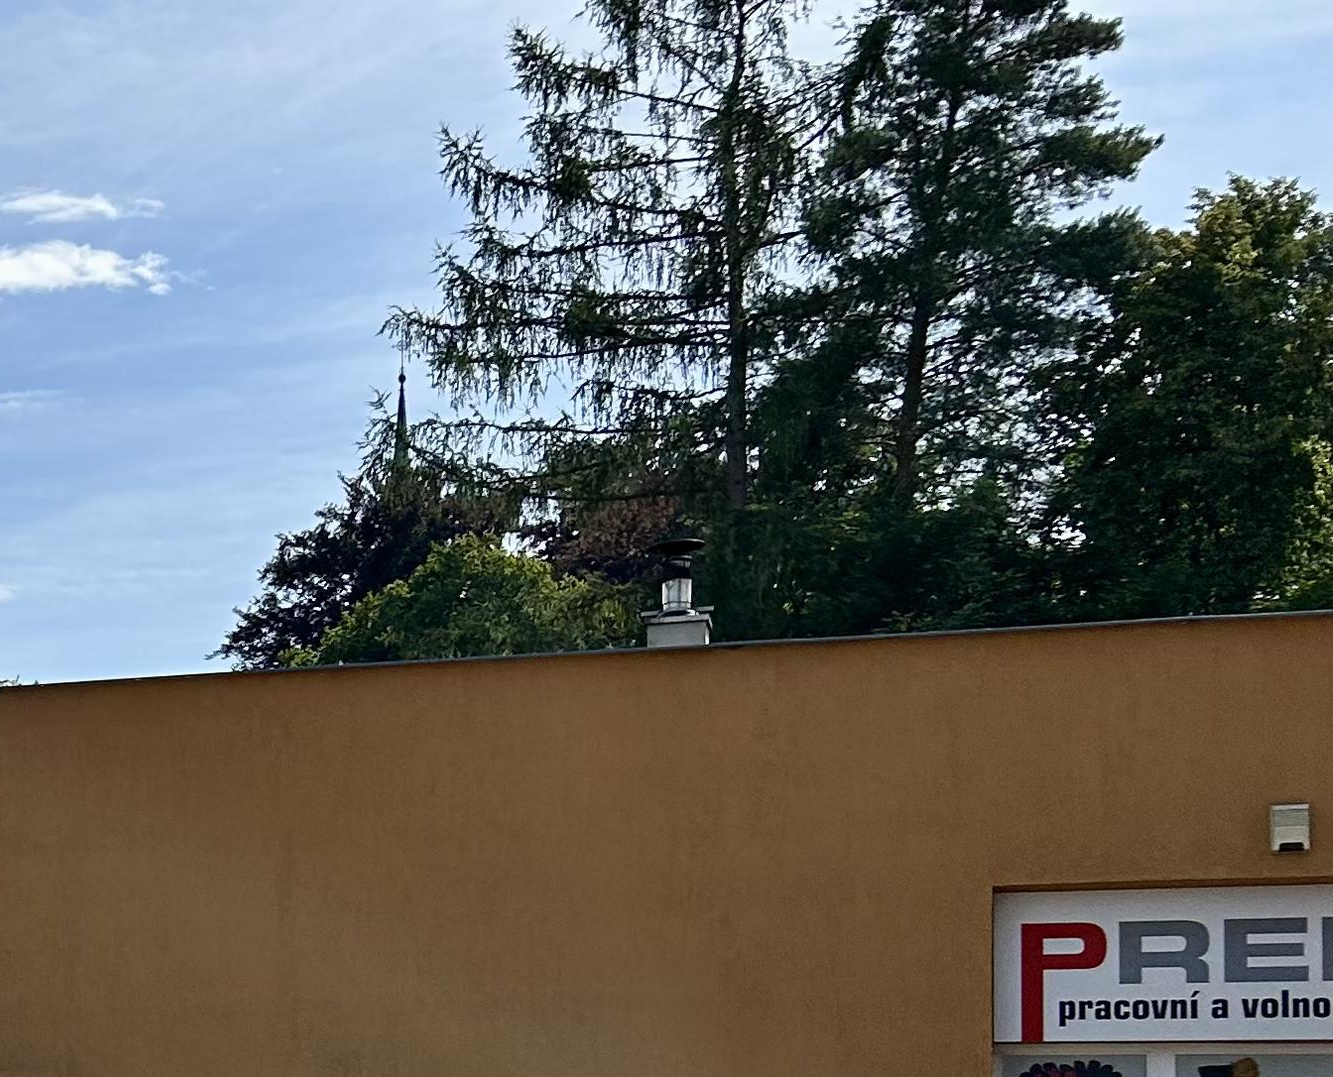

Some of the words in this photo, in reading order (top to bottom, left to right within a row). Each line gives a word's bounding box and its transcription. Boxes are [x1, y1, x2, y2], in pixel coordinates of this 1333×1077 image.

[1020, 916, 1333, 1044] PRE
[1058, 990, 1201, 1027] pracovní
[1211, 998, 1229, 1019] a
[1242, 989, 1331, 1019] volno
